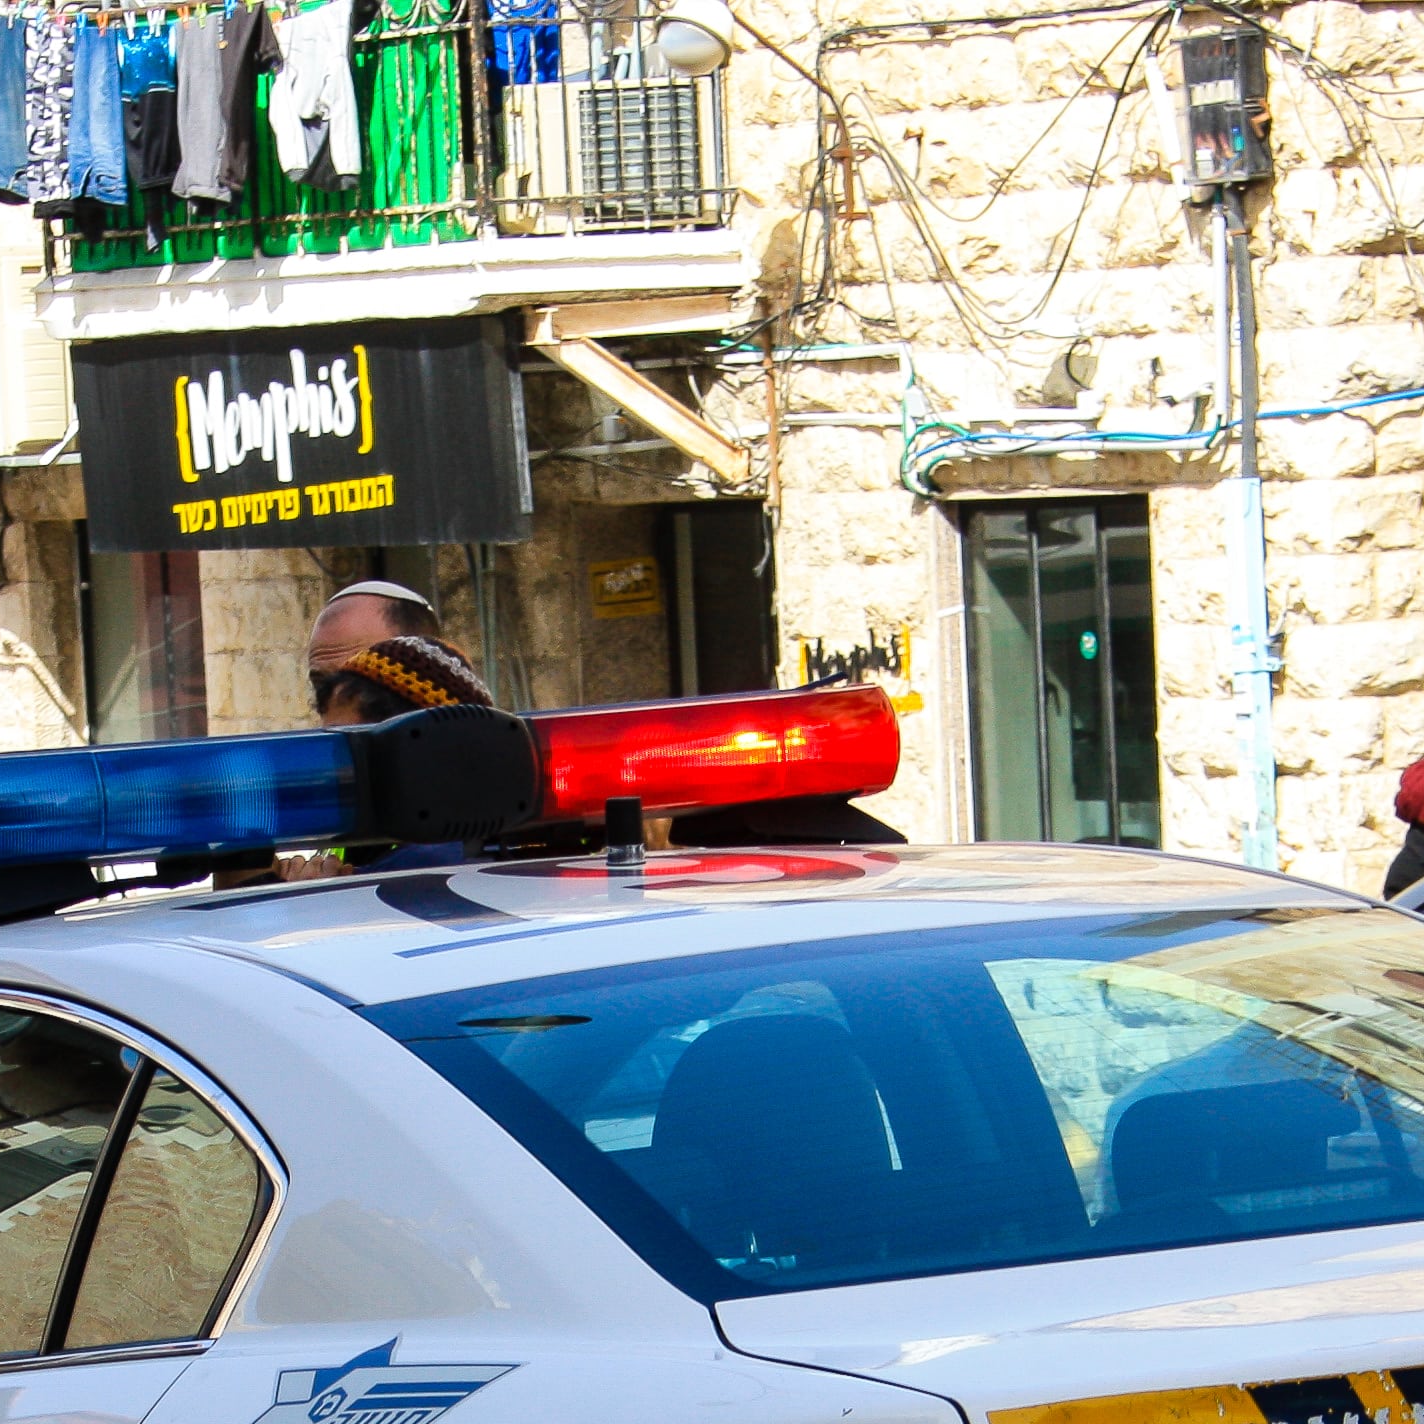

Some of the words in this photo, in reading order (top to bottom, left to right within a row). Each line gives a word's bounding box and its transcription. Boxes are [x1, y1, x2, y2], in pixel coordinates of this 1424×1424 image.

[221, 488, 300, 528] פרימיום
[305, 474, 394, 516] המבורגר
[173, 500, 217, 534] כשר
